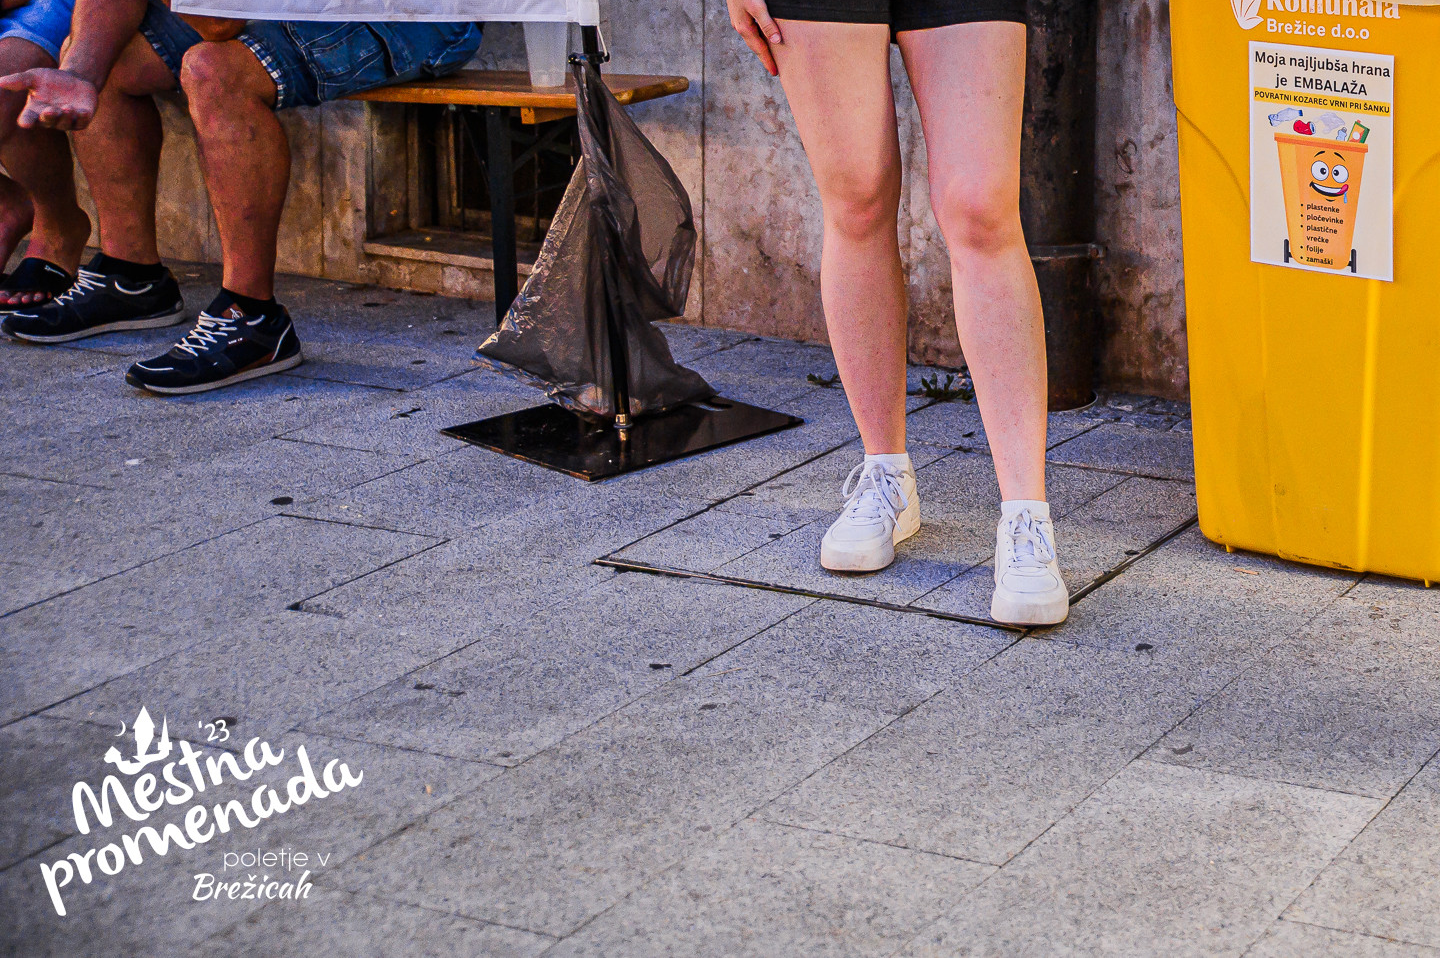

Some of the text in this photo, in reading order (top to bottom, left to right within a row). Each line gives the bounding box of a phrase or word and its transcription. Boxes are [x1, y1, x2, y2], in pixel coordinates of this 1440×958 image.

[1267, 18, 1370, 40] Brežice d.o.o
[1255, 51, 1391, 78] Moja najljubša hrana
[1275, 74, 1368, 96] je EMBALAŽA
[1254, 91, 1390, 114] POVRATNI KOZAREC VRNI PRI ŠANKU
[1306, 203, 1340, 213] plastenke
[1306, 213, 1344, 224] pločevinke
[1306, 224, 1338, 234] plastične
[1306, 235, 1329, 244] vrečke
[1306, 245, 1324, 254] folije
[1306, 256, 1334, 265] zamaški
